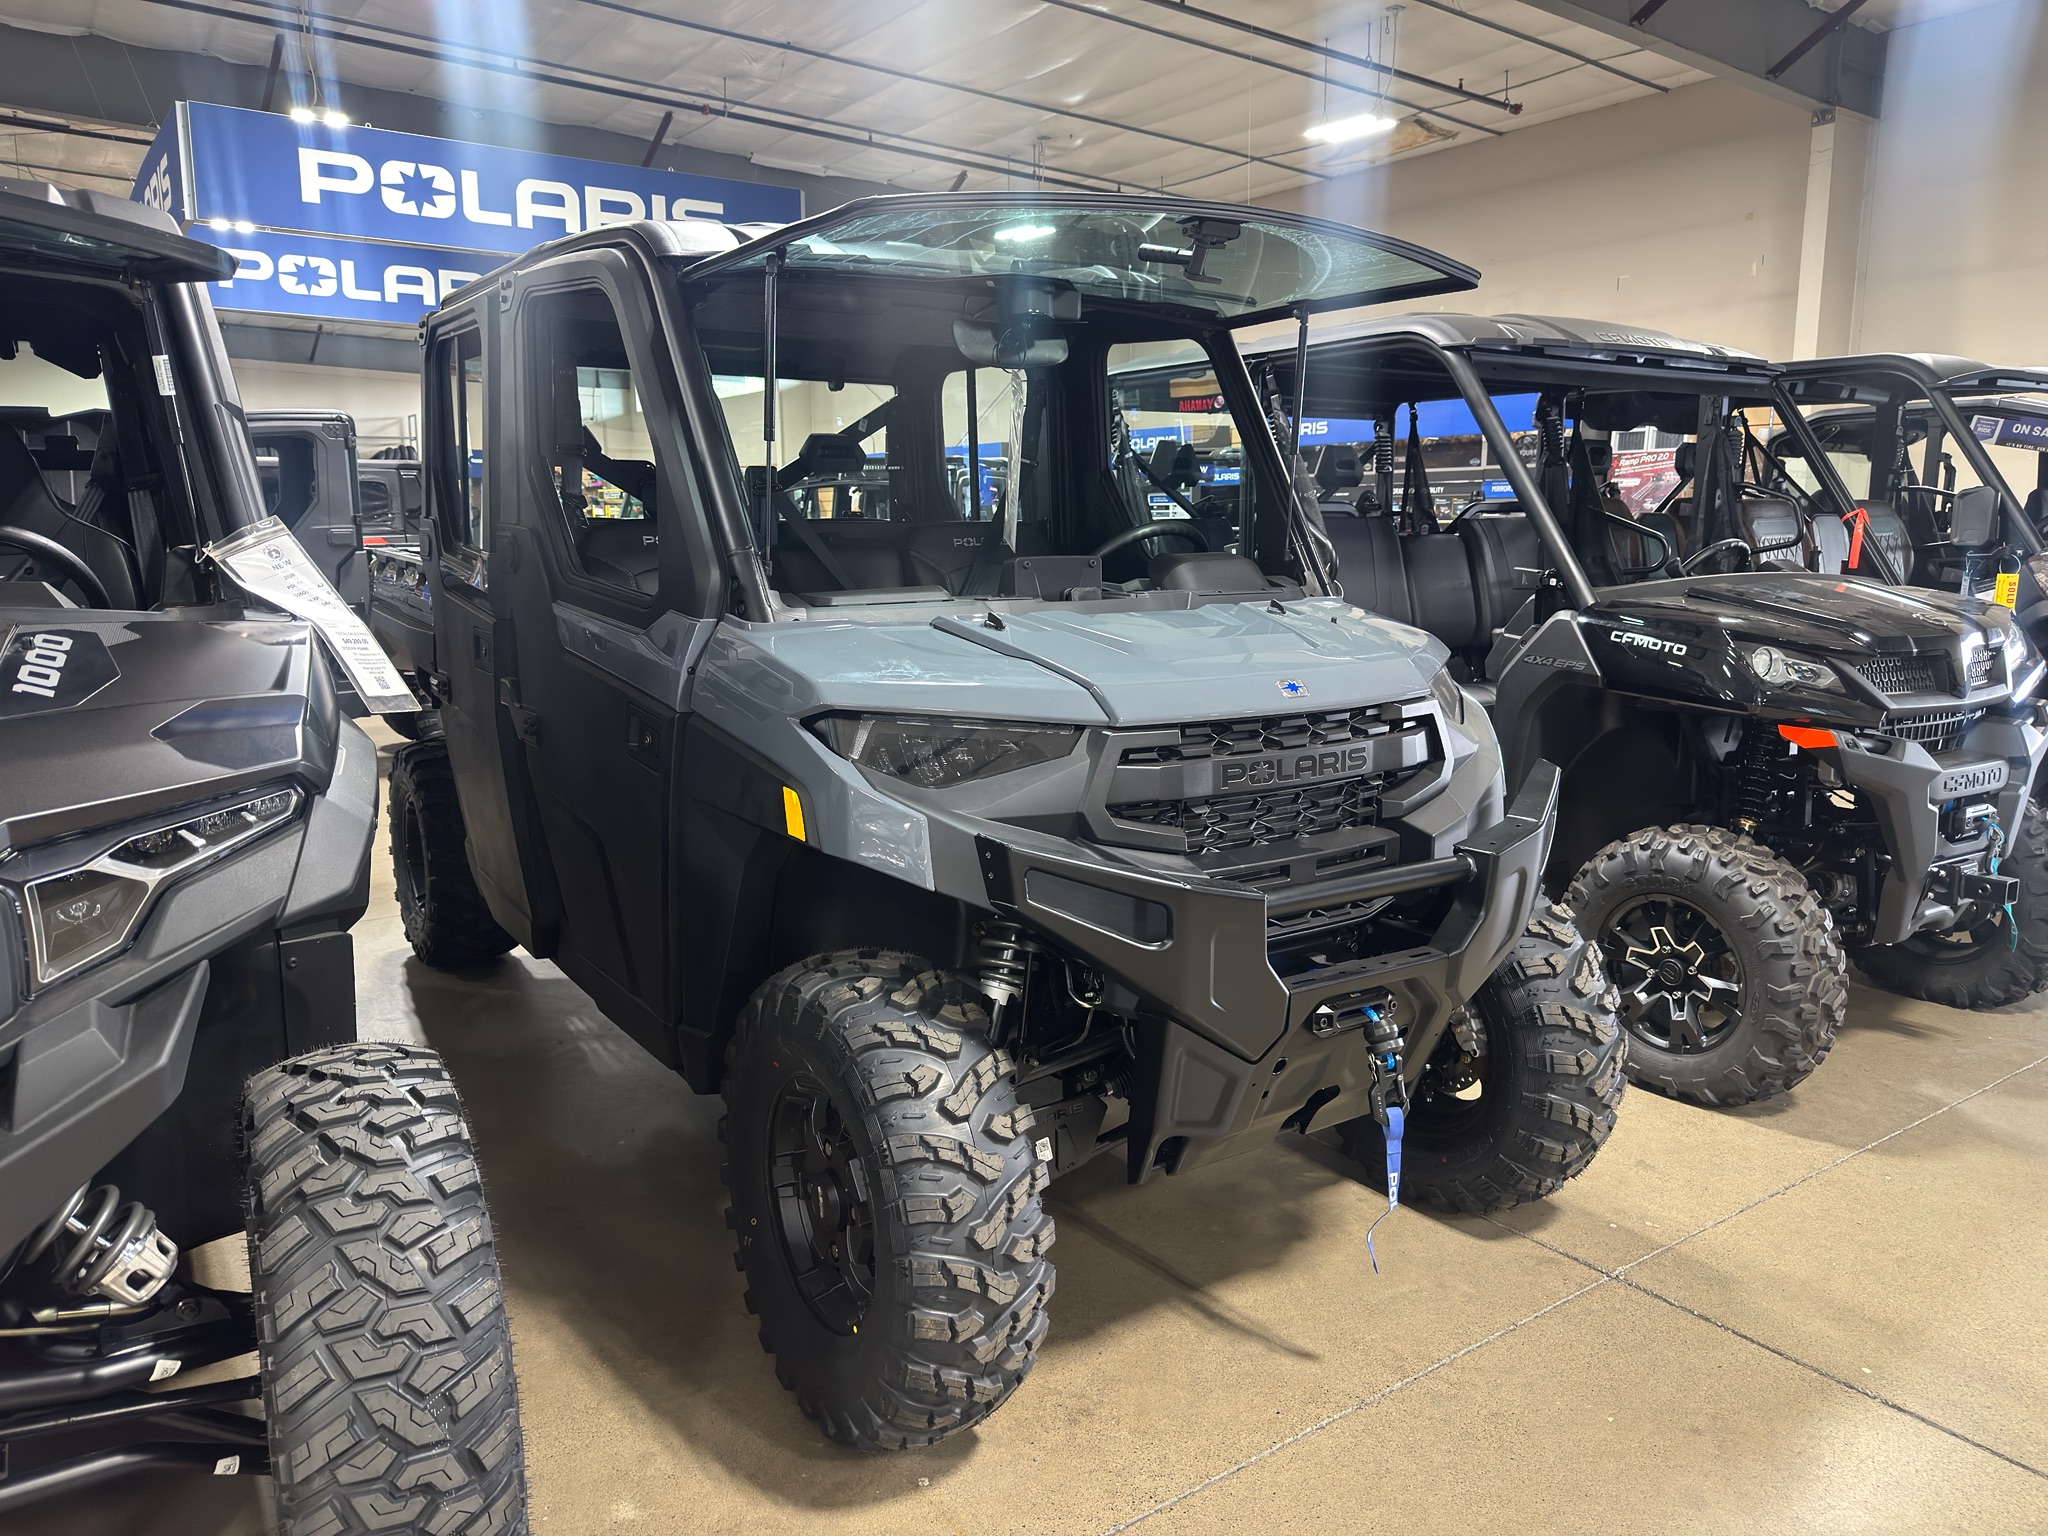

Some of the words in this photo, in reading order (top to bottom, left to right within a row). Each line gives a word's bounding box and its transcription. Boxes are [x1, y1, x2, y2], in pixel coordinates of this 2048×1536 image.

[1594, 331, 1672, 348] CFMOTO
[2012, 423, 2031, 435] ON
[1619, 459, 1640, 467] Ramp
[1640, 455, 1657, 463] PRO
[271, 558, 292, 571] NEW
[2006, 581, 2017, 604] SOLD
[1610, 630, 1687, 656] CFMOTO
[12, 633, 73, 698] 1000
[1523, 655, 1552, 666] 4X4
[1553, 659, 1588, 671] EPS
[1221, 747, 1367, 789] POLARIS
[1943, 767, 2002, 792] CFMOTO
